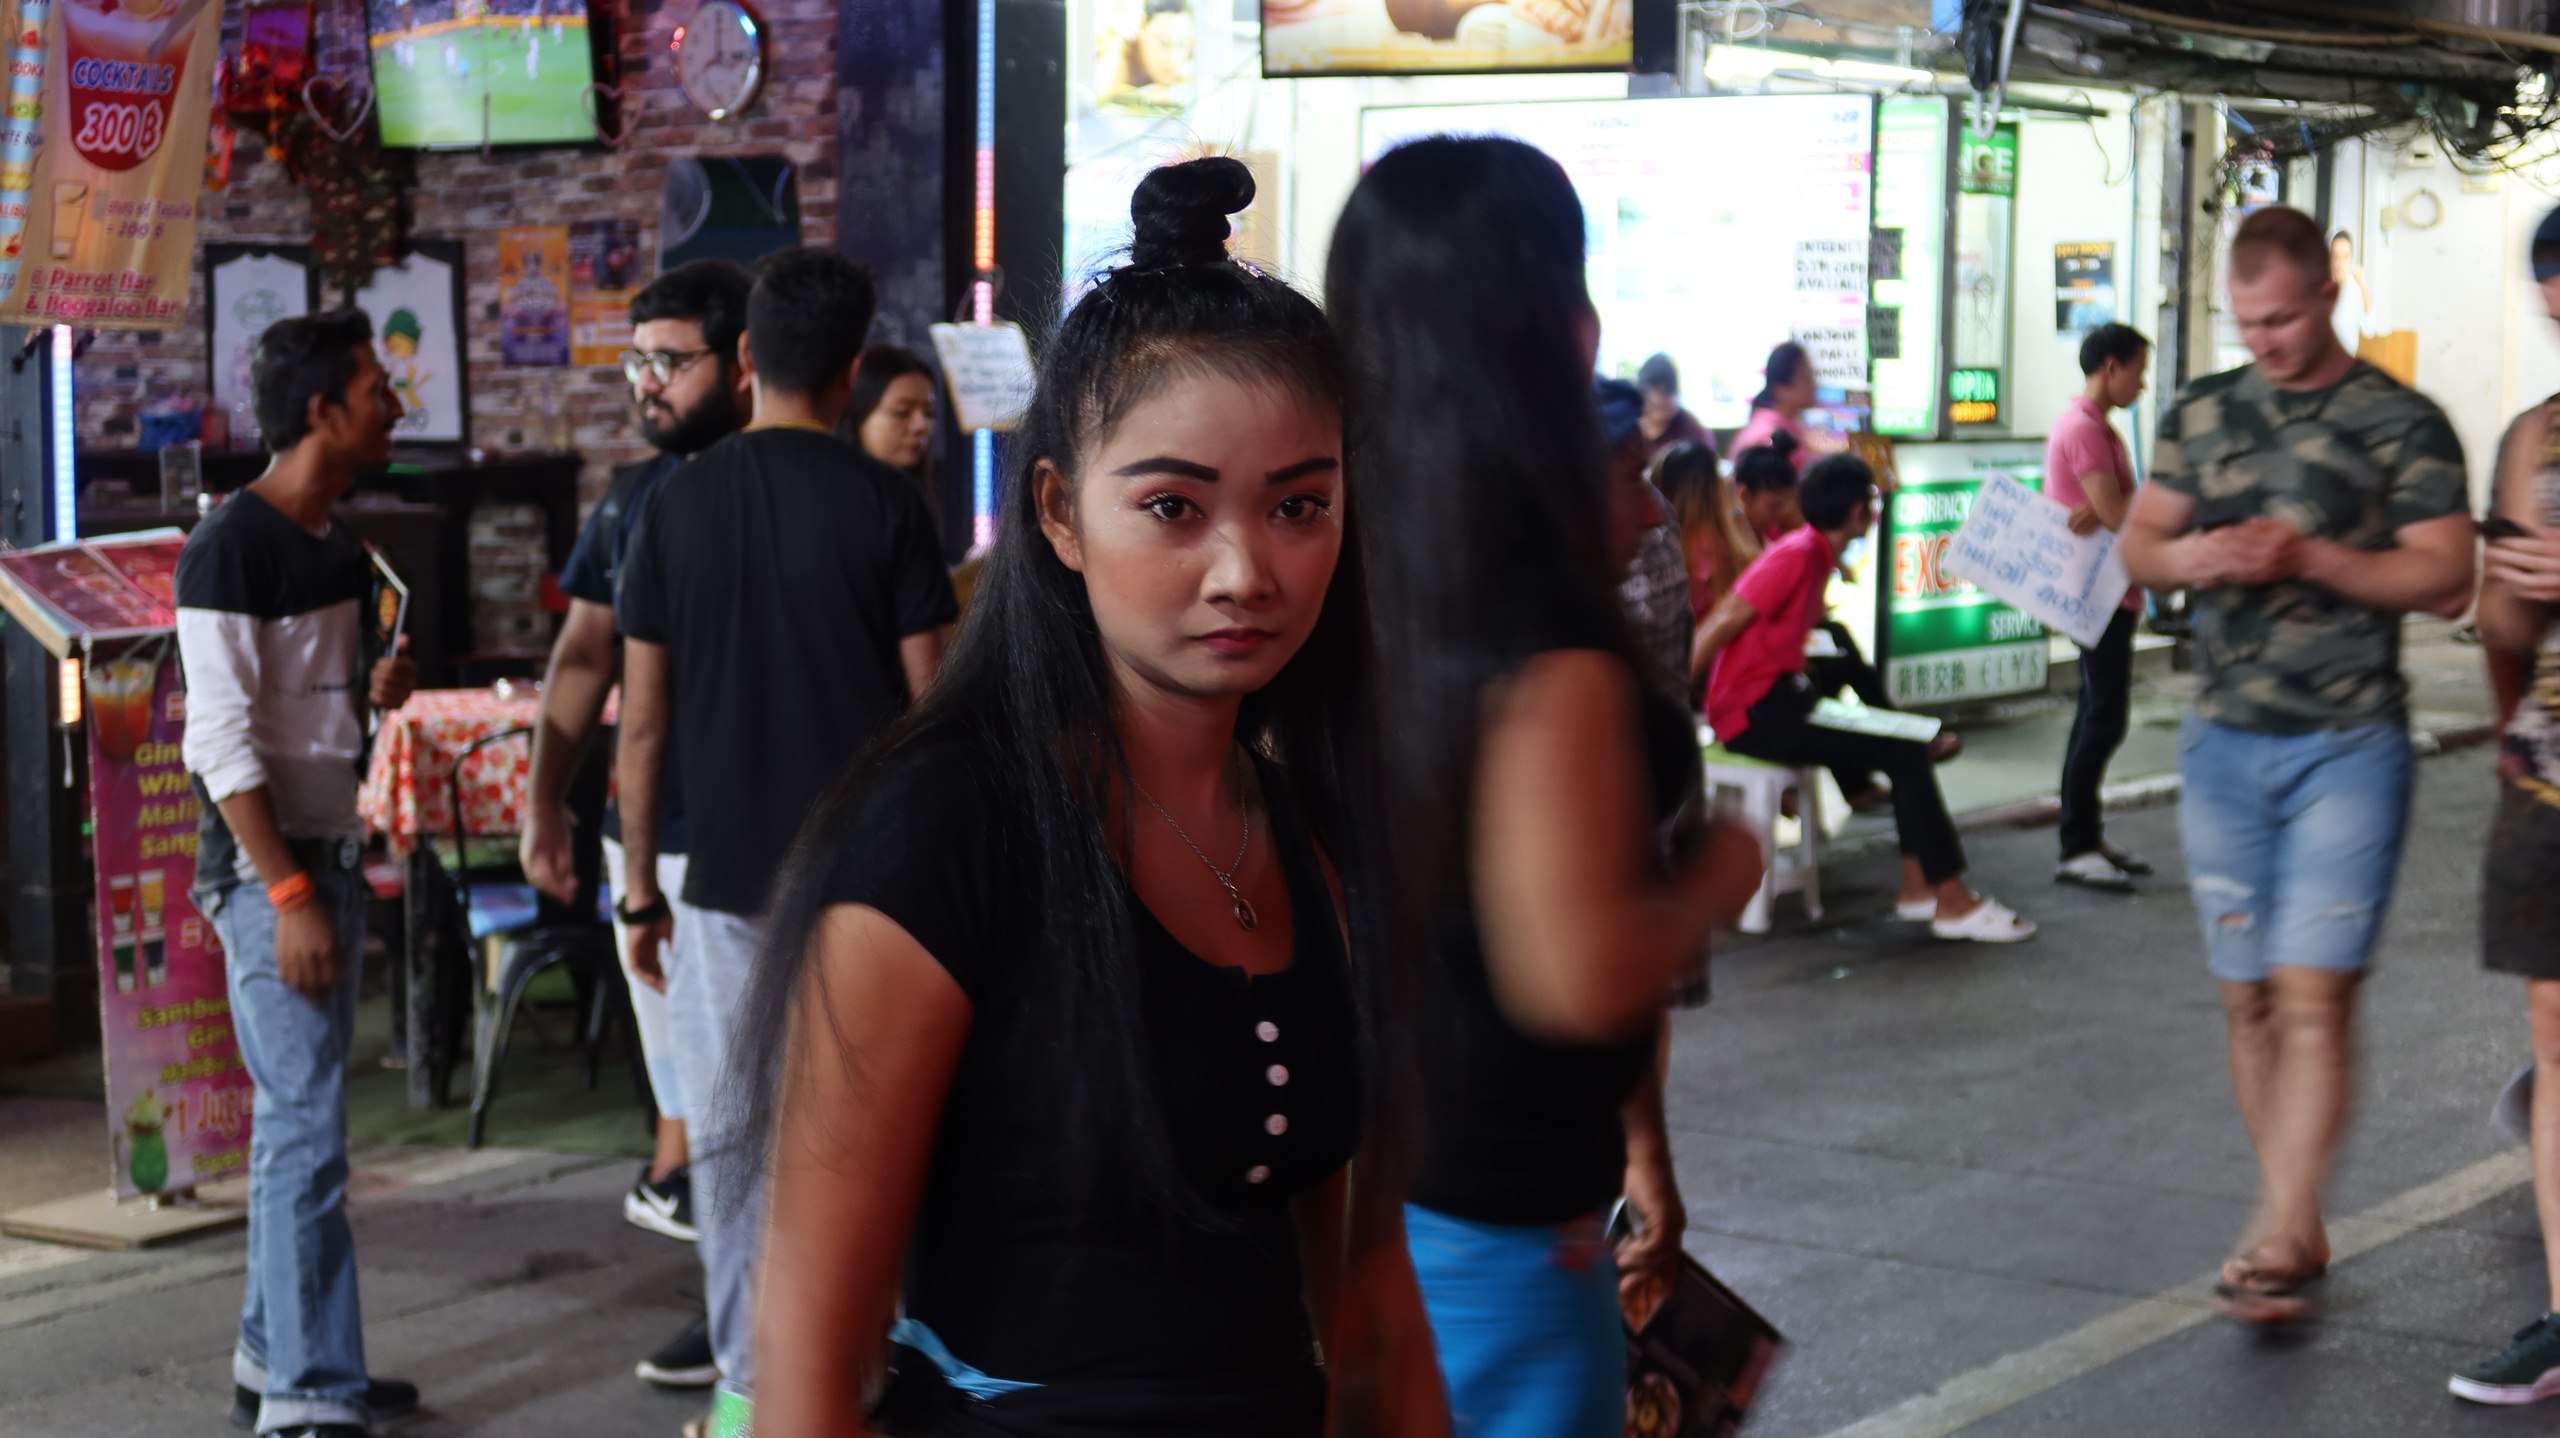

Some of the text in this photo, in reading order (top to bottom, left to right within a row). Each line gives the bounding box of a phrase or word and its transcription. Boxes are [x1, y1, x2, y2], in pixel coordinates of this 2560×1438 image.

[49, 266, 116, 292] Parrot
[119, 269, 156, 293] Bar
[25, 292, 180, 322] & Boogaloo Bar
[1949, 370, 1996, 401] OPEN
[1894, 490, 1973, 526] CURRENCY
[196, 1085, 240, 1139] Jug
